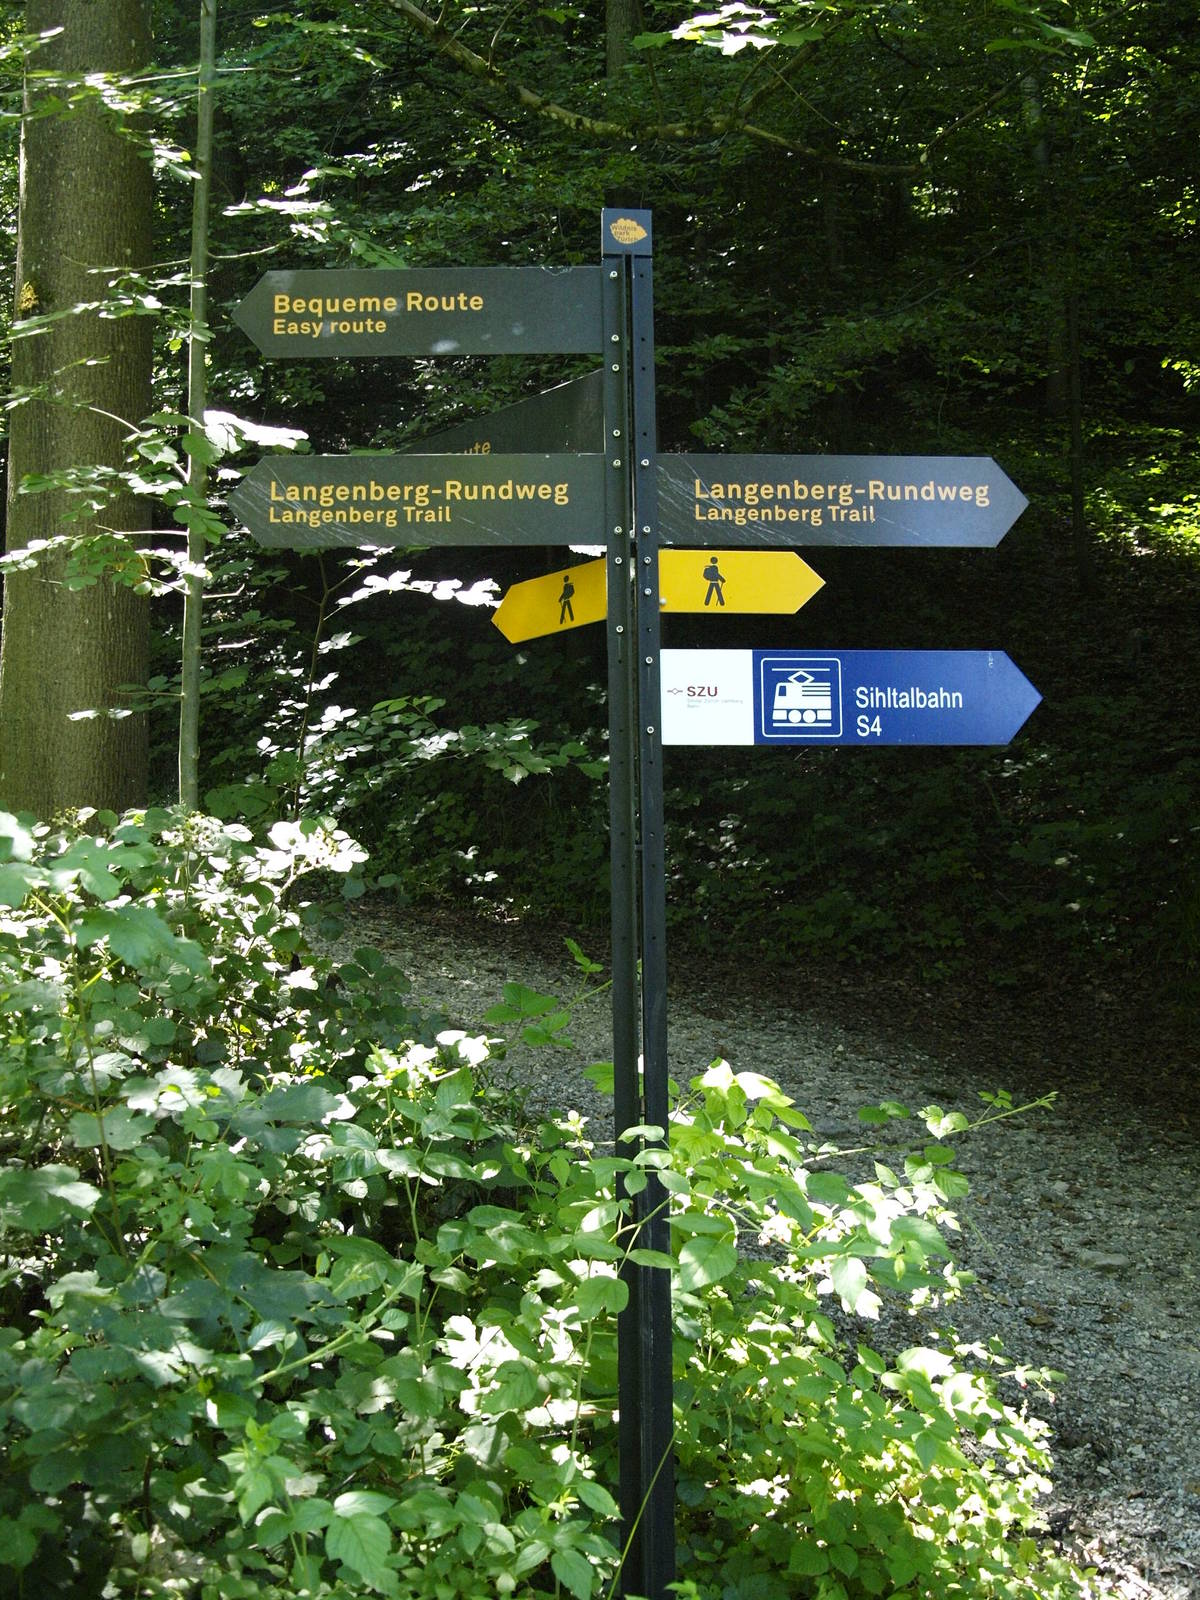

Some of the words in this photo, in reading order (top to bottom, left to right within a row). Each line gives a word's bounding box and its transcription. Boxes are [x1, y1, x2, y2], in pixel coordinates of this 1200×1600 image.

[273, 294, 398, 318] Bequeme
[406, 292, 484, 312] Route
[273, 318, 323, 338] Easy
[329, 318, 387, 334] route
[270, 480, 569, 507] Langenberg-Rundweg
[694, 479, 990, 507] Langenberg-Rundweg
[268, 506, 398, 528] Langenberg
[403, 506, 452, 523] Trail
[694, 504, 823, 526] Langenberg
[828, 505, 876, 523] Trail
[686, 686, 718, 697] SZU
[855, 686, 963, 709] Sihltalbahn
[856, 715, 883, 737] S4
